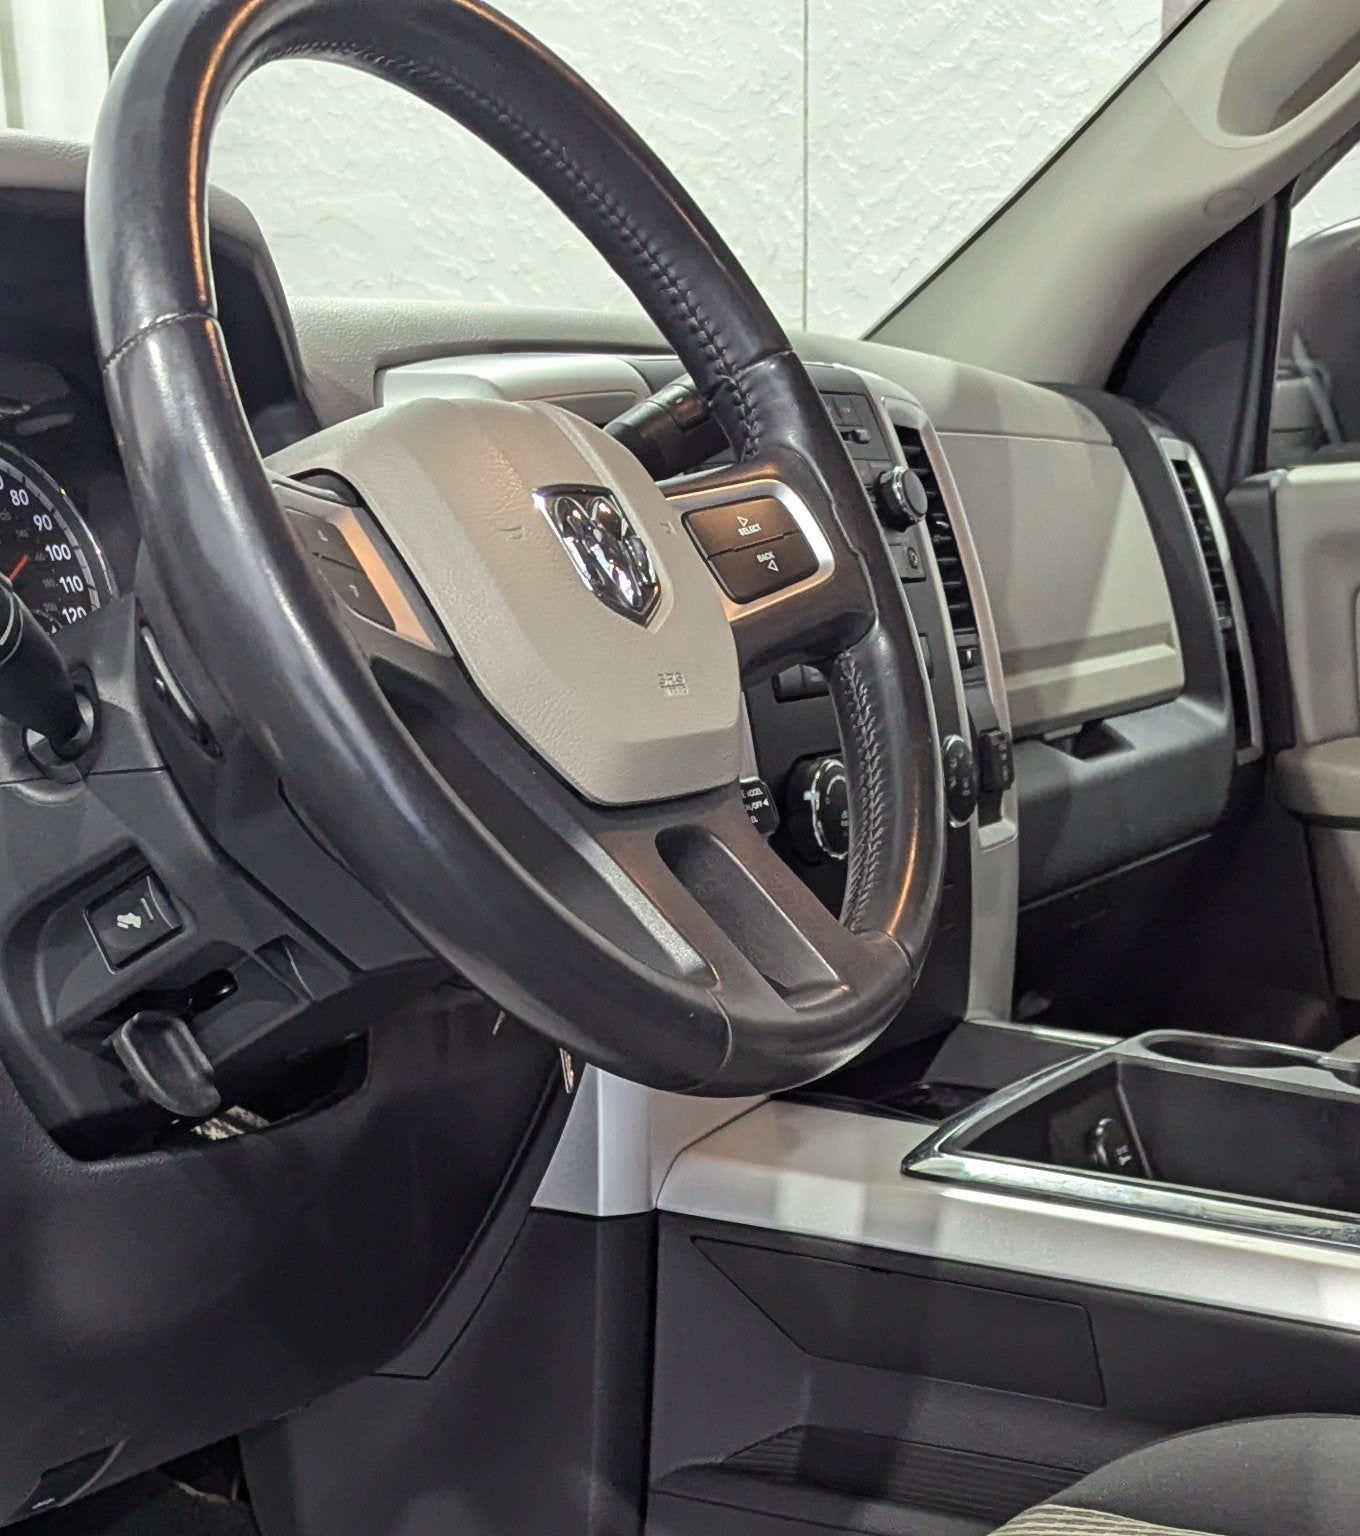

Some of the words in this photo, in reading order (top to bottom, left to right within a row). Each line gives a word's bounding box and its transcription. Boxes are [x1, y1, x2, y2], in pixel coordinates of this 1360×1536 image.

[9, 489, 29, 506] 80
[33, 514, 53, 532] 90
[738, 523, 762, 536] SELECT
[45, 543, 71, 561] 100
[756, 551, 775, 563] BACK
[60, 575, 84, 593] 110
